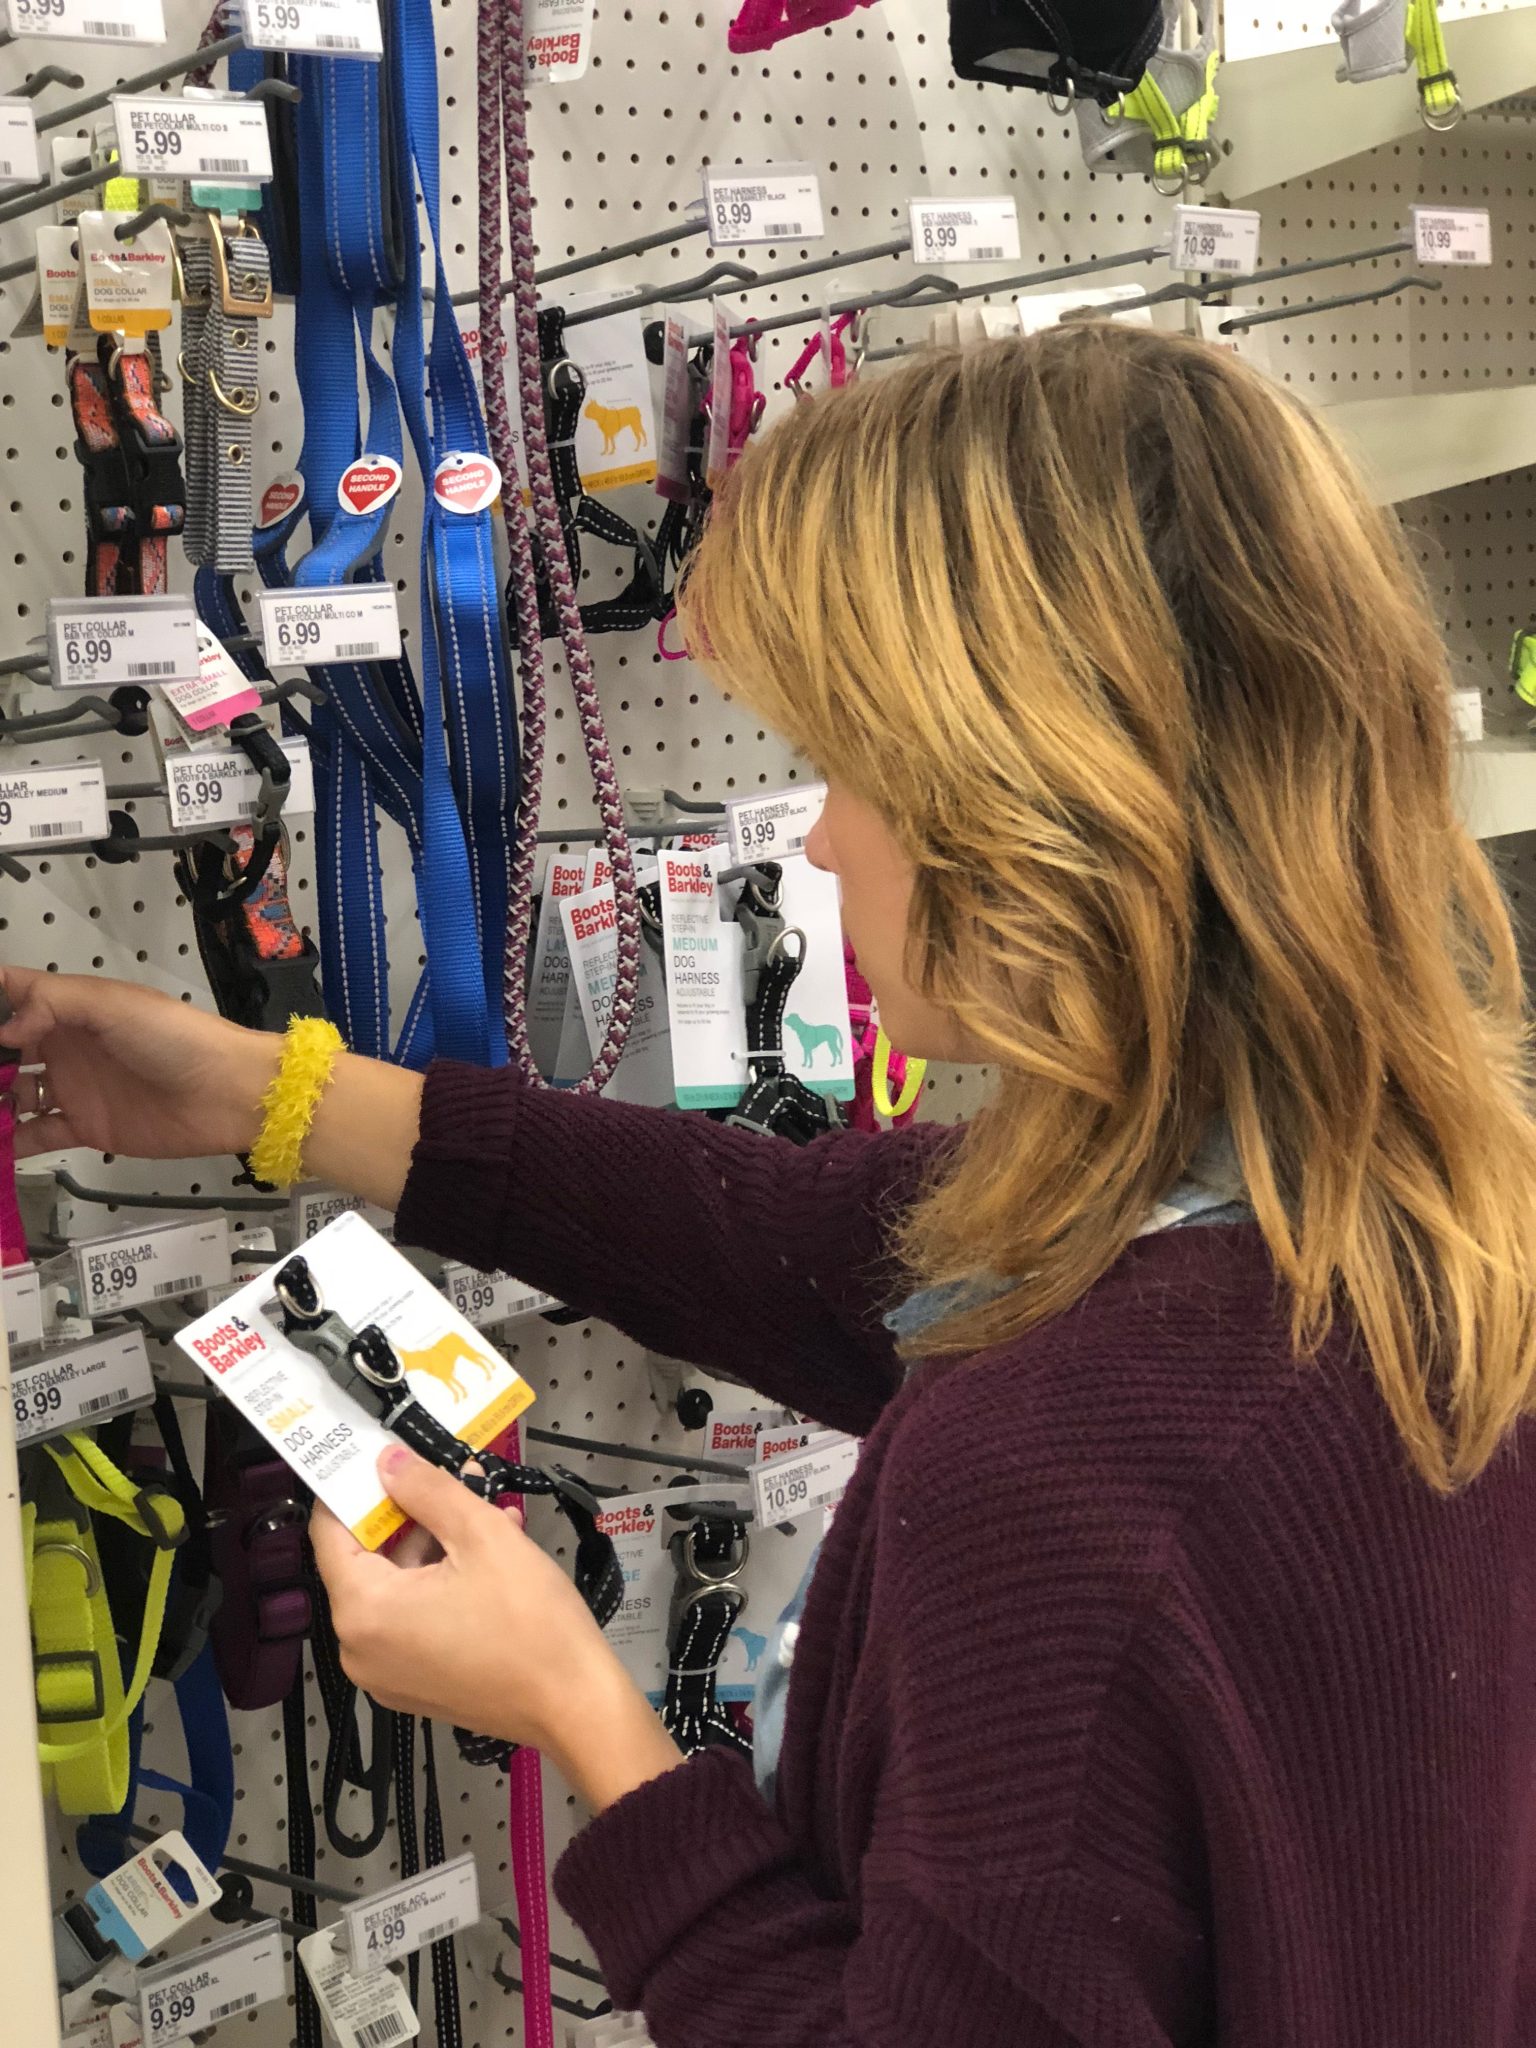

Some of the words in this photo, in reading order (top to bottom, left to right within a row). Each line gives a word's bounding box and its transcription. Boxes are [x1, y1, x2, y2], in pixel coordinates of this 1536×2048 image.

[258, 5, 300, 29] 5.99
[527, 33, 580, 52] Barkley
[527, 55, 537, 70] &
[538, 49, 579, 67] Boots
[130, 111, 149, 122] PET
[153, 113, 195, 123] COLLAR
[144, 122, 184, 131] PETCOLAR
[187, 123, 208, 131] MULTI
[135, 130, 182, 155] 5.99
[713, 188, 728, 196] PET
[731, 186, 767, 195] HARNESS
[716, 203, 751, 225] 8.99
[921, 213, 934, 221] PET
[937, 211, 971, 221] HARNESS
[924, 227, 957, 247] 8.99
[1184, 236, 1215, 256] 10.99
[1422, 231, 1451, 248] 10.99
[94, 288, 113, 296] DOG
[115, 287, 147, 295] COLLAR
[49, 304, 69, 312] DOG
[350, 473, 390, 483] SECOND
[442, 469, 485, 486] SECOND
[349, 483, 386, 493] HANDLE
[445, 480, 486, 495] HANDLE
[275, 606, 292, 616] PET
[295, 604, 333, 615] COLLAR
[287, 613, 322, 622] PETCOLAR
[324, 612, 344, 620] MULTI
[64, 622, 82, 633] PET
[86, 620, 126, 632] COLLAR
[98, 630, 126, 639] COLLAR
[278, 622, 320, 646] 6.99
[66, 639, 112, 664] 6.99
[175, 692, 193, 703] DOG
[193, 681, 219, 697] COLLAR
[174, 764, 193, 775] PET
[195, 761, 237, 773] COLLAR
[174, 774, 200, 783] BOOTS
[208, 770, 242, 780] BARKLEY
[37, 787, 68, 797] MEDIUM
[176, 780, 222, 806] 6.99
[738, 810, 752, 820] PET
[754, 802, 790, 816] HARNESS
[789, 806, 808, 816] BLACK
[741, 821, 775, 847] 9.99
[666, 861, 702, 877] Boots
[703, 863, 712, 878] &
[668, 877, 714, 897] Barkley
[570, 898, 615, 926] Boots
[672, 937, 719, 951] MEDIUM
[674, 955, 695, 968] DOG
[674, 972, 720, 985] HARNESS
[676, 987, 716, 997] ADJUSTABLE
[306, 1202, 324, 1211] PET
[88, 1253, 108, 1265] PET
[110, 1244, 153, 1262] COLLAR
[106, 1260, 120, 1269] YEL
[122, 1254, 153, 1265] COLLAR
[91, 1265, 138, 1296] 8.99
[453, 1276, 470, 1286] PET
[456, 1286, 494, 1314] 9.99
[192, 1324, 239, 1358] Boots
[231, 1316, 250, 1332] &
[208, 1332, 266, 1375] Barkley
[11, 1379, 31, 1391] PET
[31, 1363, 75, 1385] COLLAR
[45, 1369, 80, 1388] BARKLEY
[81, 1360, 107, 1375] LARGE
[14, 1387, 61, 1421] 8.99
[266, 1397, 315, 1435] SMALL
[713, 1423, 753, 1435] Boots
[754, 1422, 764, 1434] &
[283, 1425, 314, 1452] DOG
[299, 1422, 353, 1469] HARNESS
[711, 1436, 757, 1450] Barkle
[763, 1438, 798, 1455] Boots
[799, 1435, 808, 1447] &
[763, 1475, 777, 1485] PET
[778, 1462, 813, 1479] HARNESS
[766, 1480, 807, 1510] 10.99
[594, 1505, 641, 1525] Boots
[643, 1503, 655, 1517] &
[115, 1874, 129, 1892] DOG
[127, 1890, 149, 1918] COLLAR
[137, 1857, 183, 1920] Boots&Barkley
[364, 1911, 380, 1924] PET
[409, 1892, 427, 1905] ACC
[367, 1919, 405, 1951] 4.99
[148, 1989, 167, 2002] PET
[169, 1972, 209, 1995] COLLAR
[150, 1996, 195, 2030] 9.99
